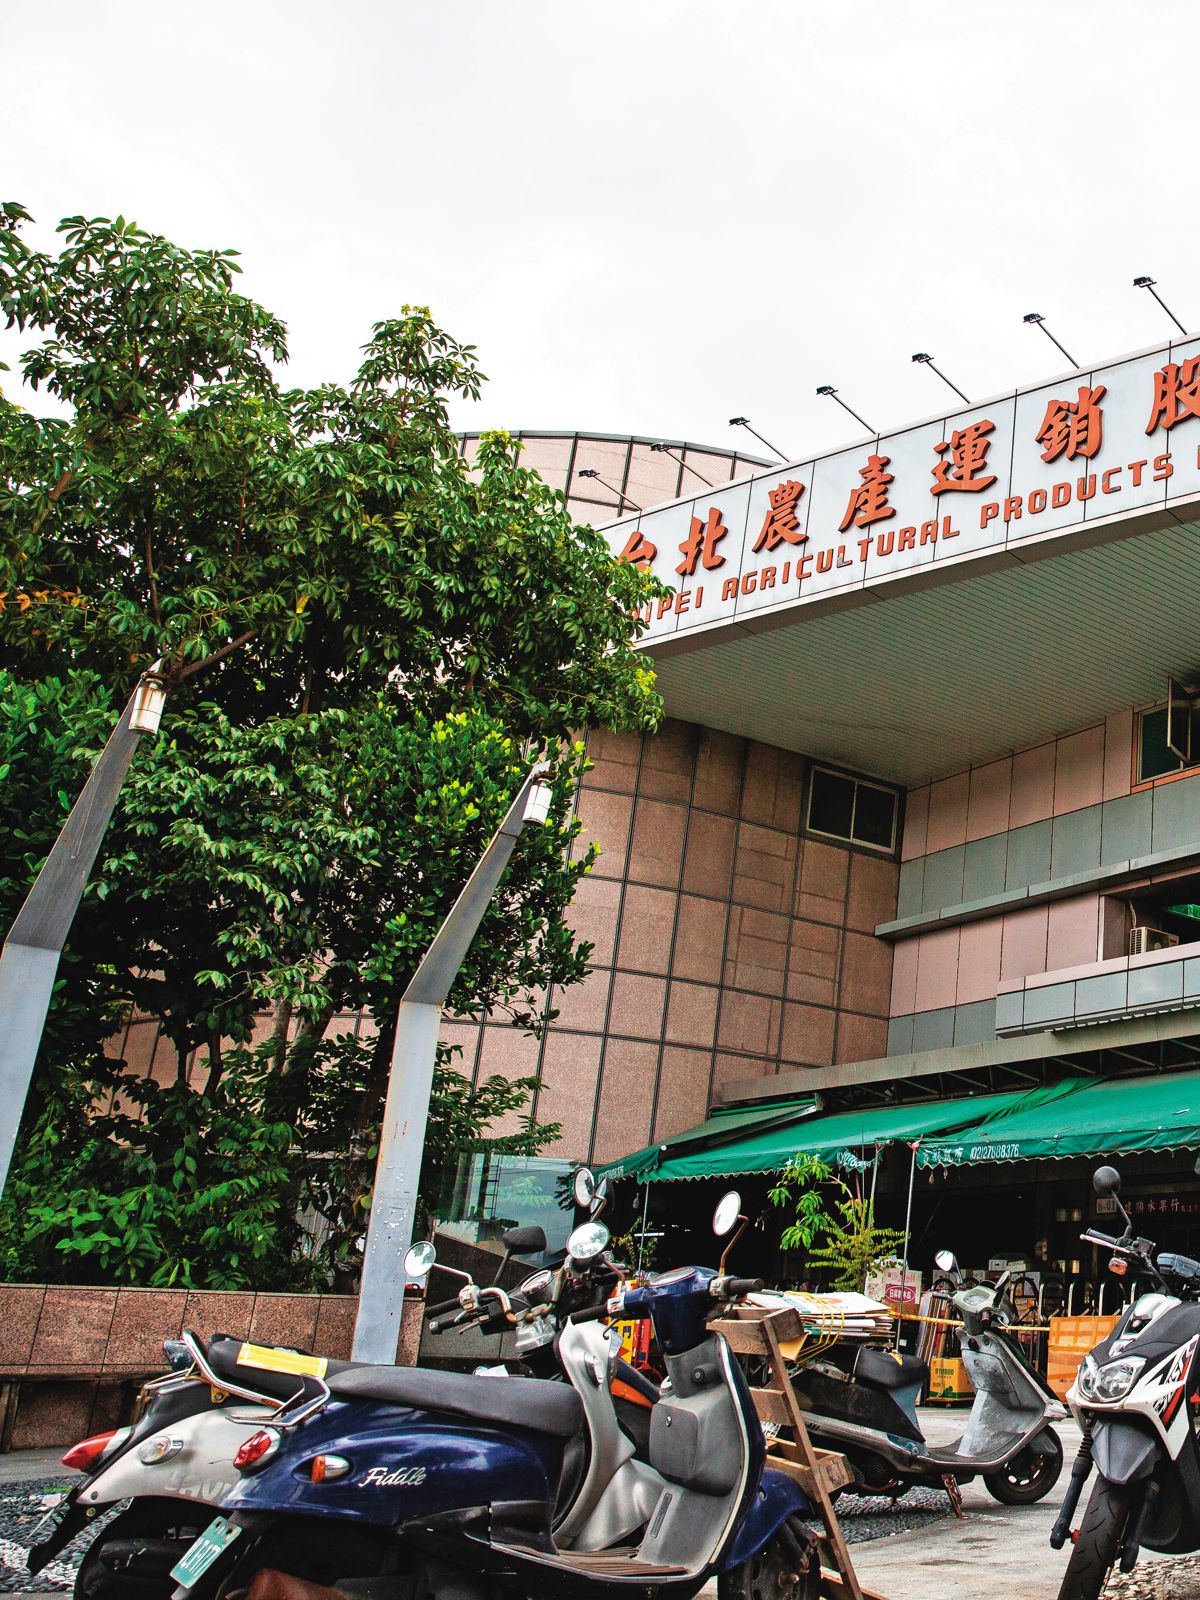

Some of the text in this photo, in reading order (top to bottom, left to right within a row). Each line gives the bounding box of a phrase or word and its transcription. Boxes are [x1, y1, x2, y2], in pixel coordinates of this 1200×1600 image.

[721, 514, 960, 601] AGRICULTURAL
[980, 454, 1174, 530] PRODUCTS
[358, 1467, 427, 1488] Fiddle
